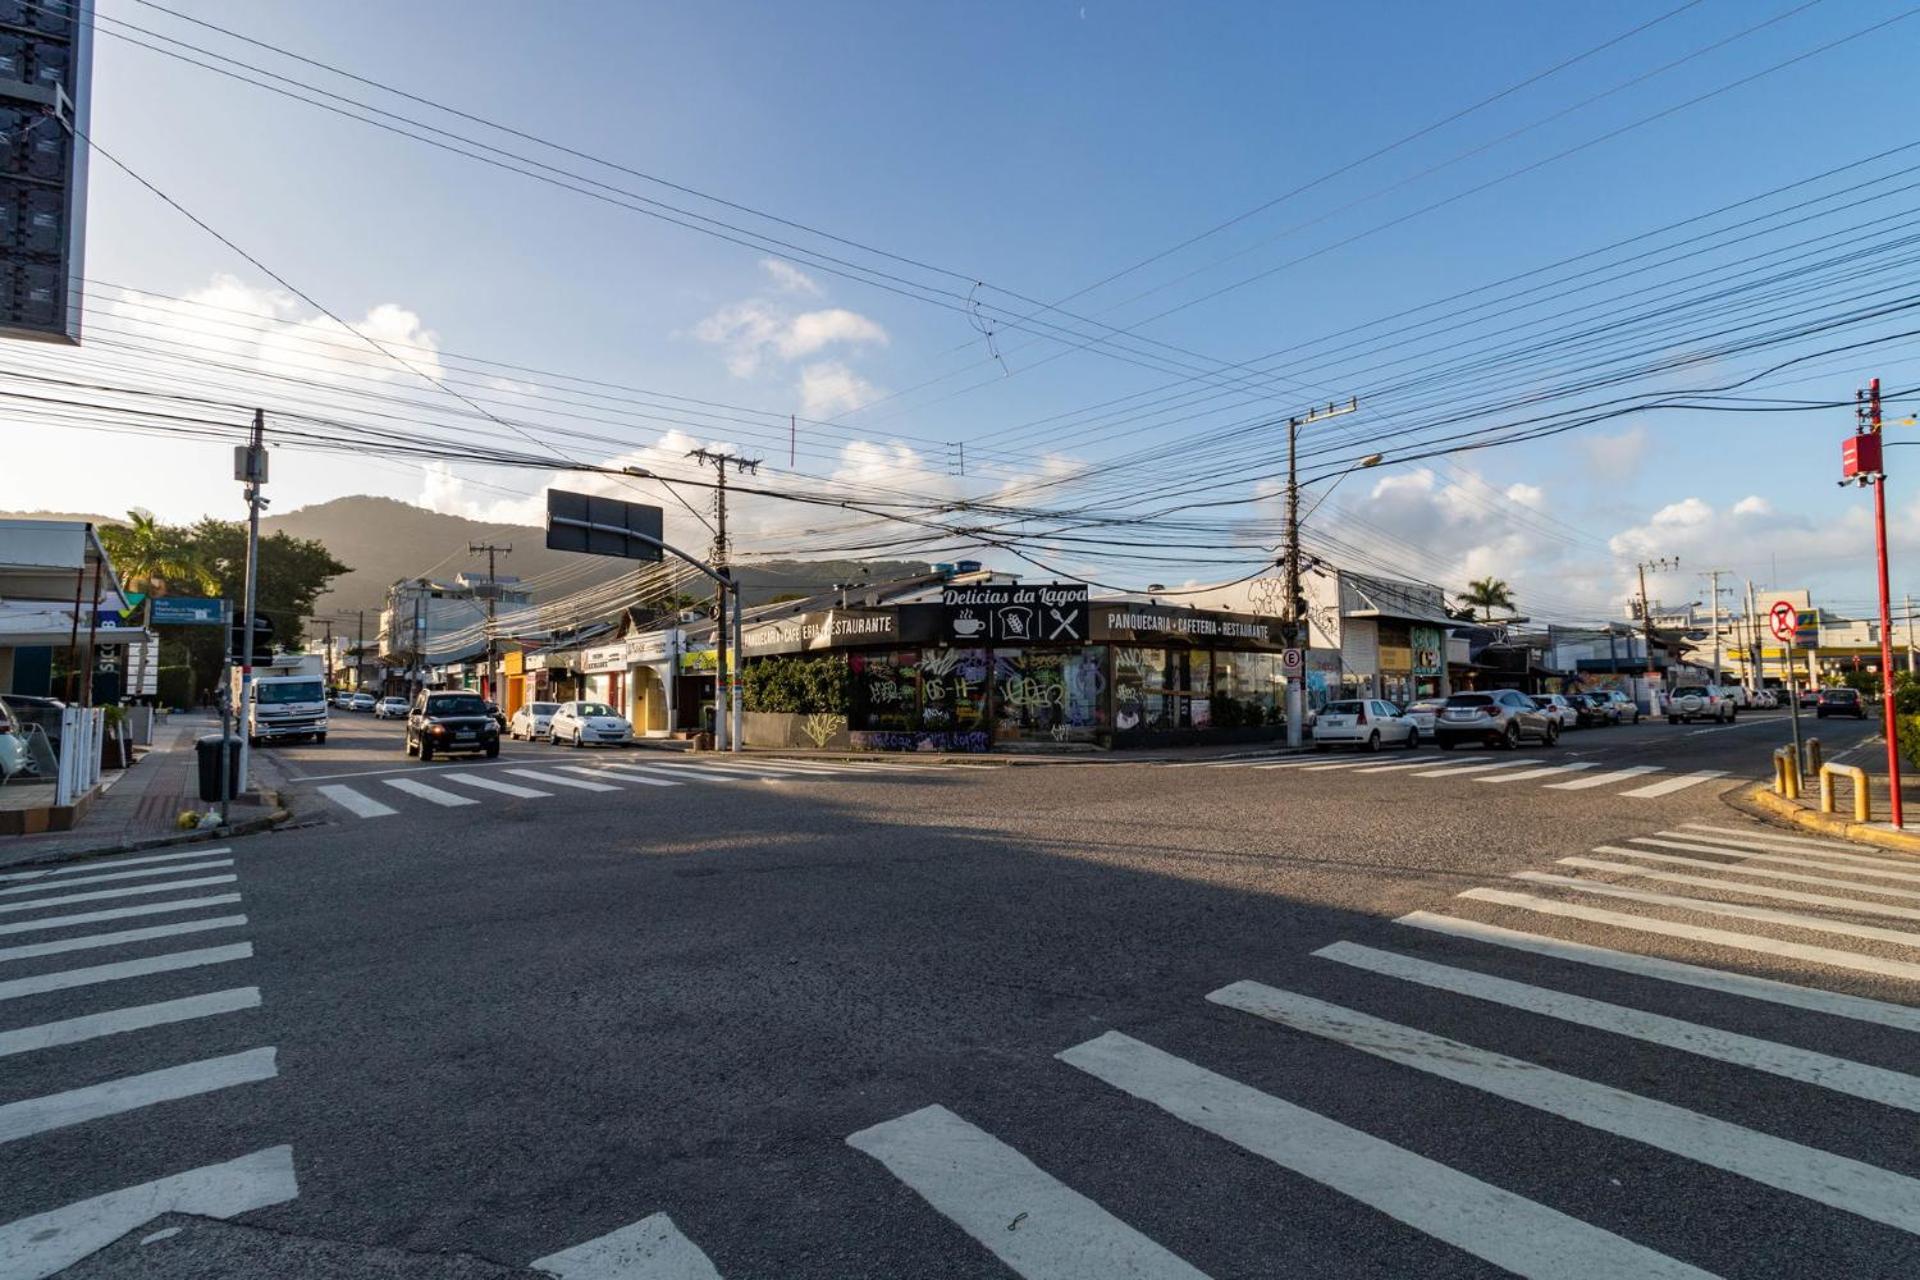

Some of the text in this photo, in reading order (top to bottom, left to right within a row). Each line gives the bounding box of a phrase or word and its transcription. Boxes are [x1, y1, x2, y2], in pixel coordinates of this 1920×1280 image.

[1013, 589, 1035, 603] da
[1039, 587, 1088, 607] Lagoa
[784, 623, 820, 642] CAFEERIA
[1107, 613, 1269, 640] PANQUECARIA CAFETERIA RESTAURANTE
[100, 620, 116, 672] SICOB
[1288, 653, 1295, 664] E
